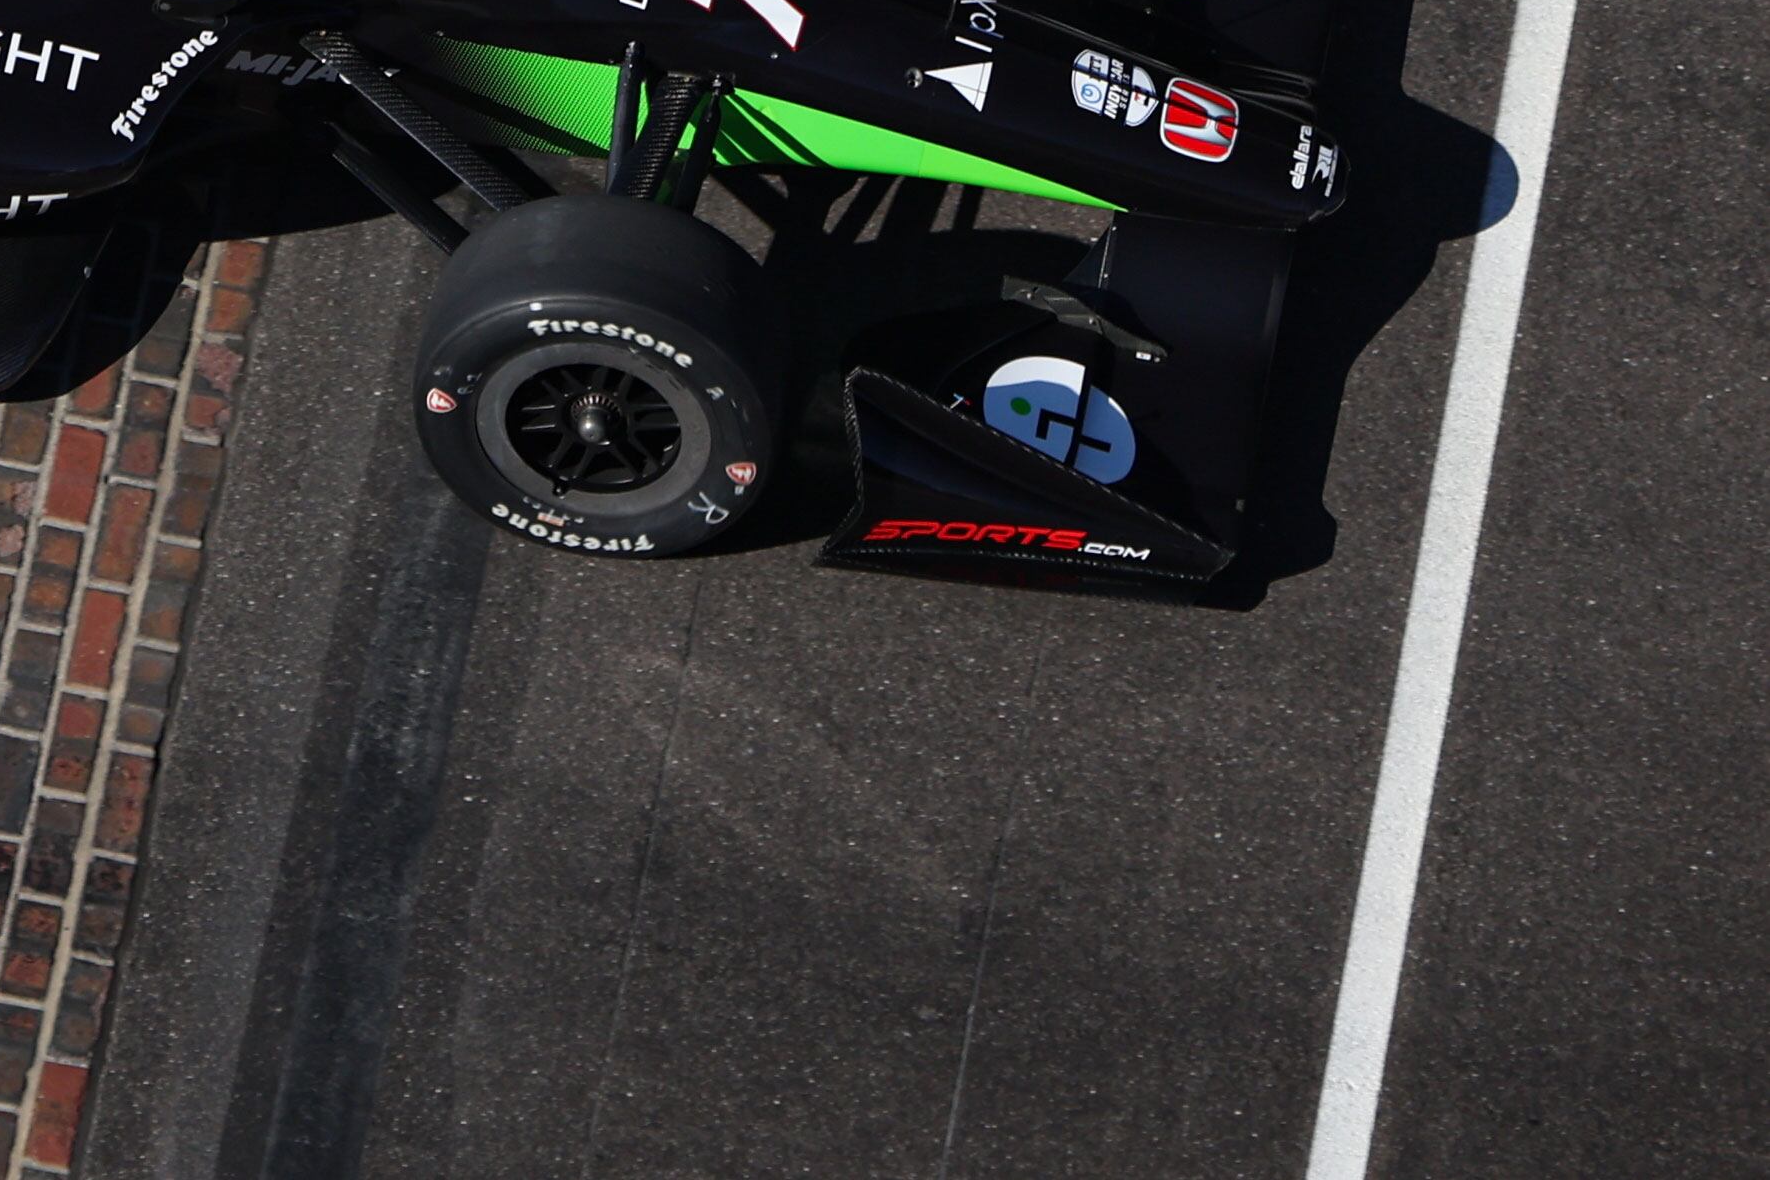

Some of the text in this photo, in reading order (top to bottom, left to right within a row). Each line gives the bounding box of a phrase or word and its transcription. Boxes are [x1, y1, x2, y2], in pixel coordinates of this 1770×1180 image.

[111, 30, 219, 143] Firestone
[224, 50, 338, 86] MI-JA
[1289, 125, 1313, 190] dallara
[527, 318, 694, 369] Firestone
[491, 503, 656, 553] Firestone
